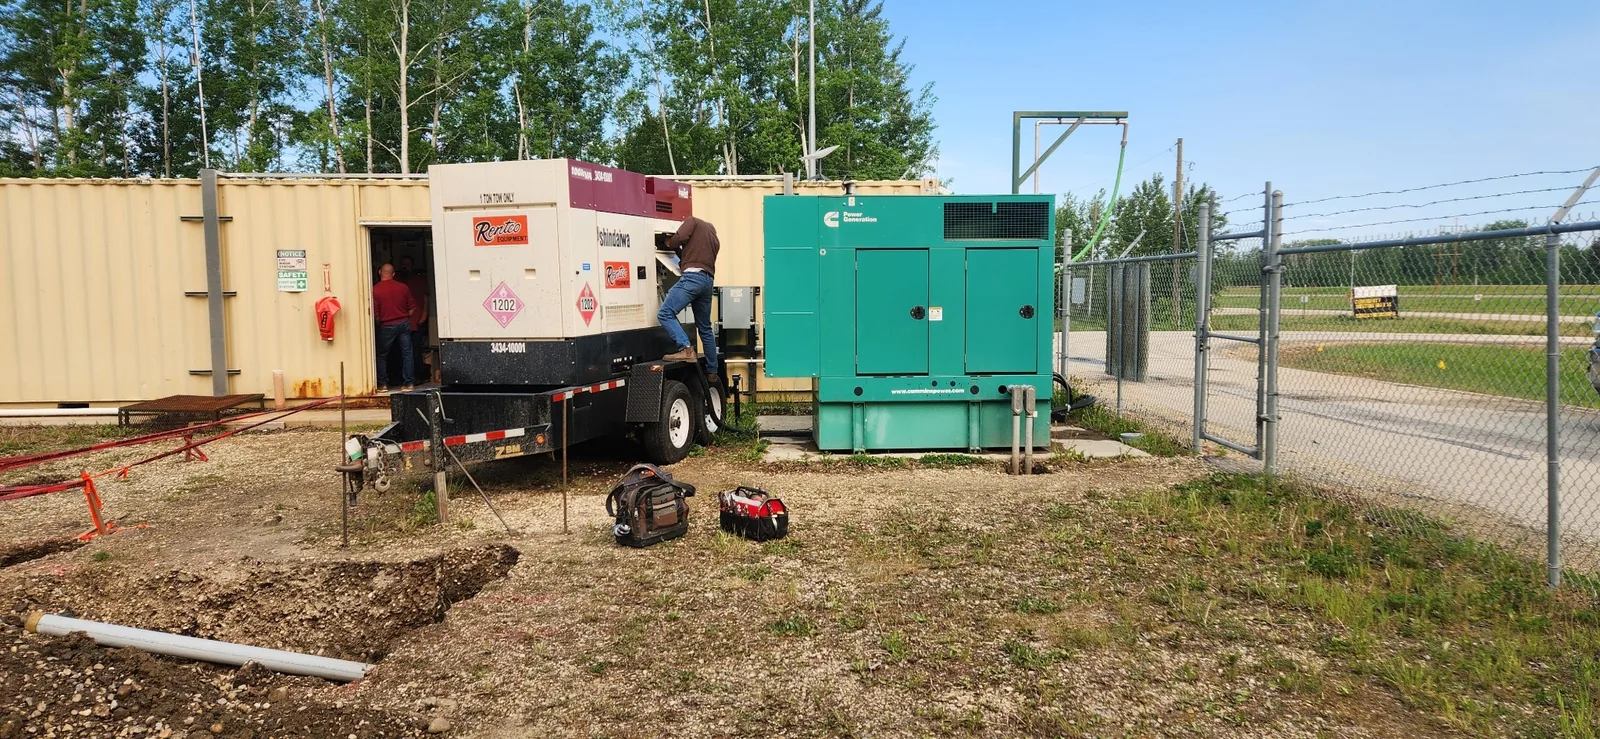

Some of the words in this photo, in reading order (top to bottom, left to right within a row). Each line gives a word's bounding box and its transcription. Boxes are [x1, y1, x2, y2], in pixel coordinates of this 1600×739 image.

[483, 193, 493, 204] TON
[493, 193, 503, 203] TOW
[503, 192, 515, 203] ONLY
[475, 220, 521, 243] Rentco
[497, 235, 528, 243] EQUIPMENT
[599, 228, 630, 248] shindaiwa
[492, 298, 516, 311] 1202
[581, 298, 594, 310] 1202
[501, 315, 508, 324] 3
[490, 342, 527, 354] 3434-10001
